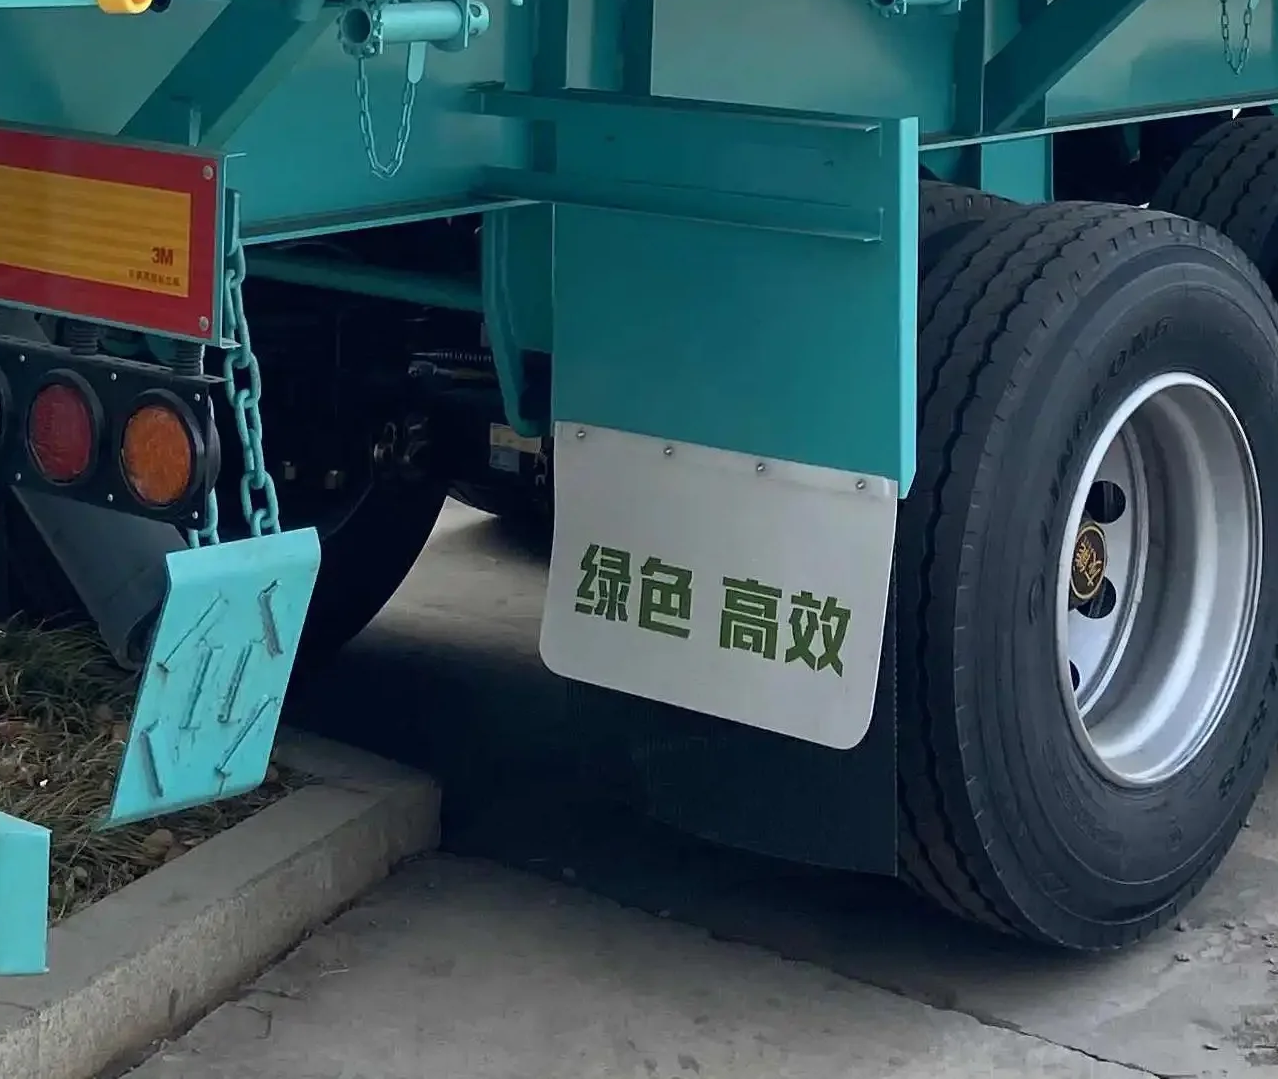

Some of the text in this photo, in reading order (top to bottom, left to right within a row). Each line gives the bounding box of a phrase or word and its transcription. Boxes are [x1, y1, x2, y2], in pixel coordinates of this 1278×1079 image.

[152, 247, 173, 266] 3M
[575, 543, 852, 678] 绿色 高效
